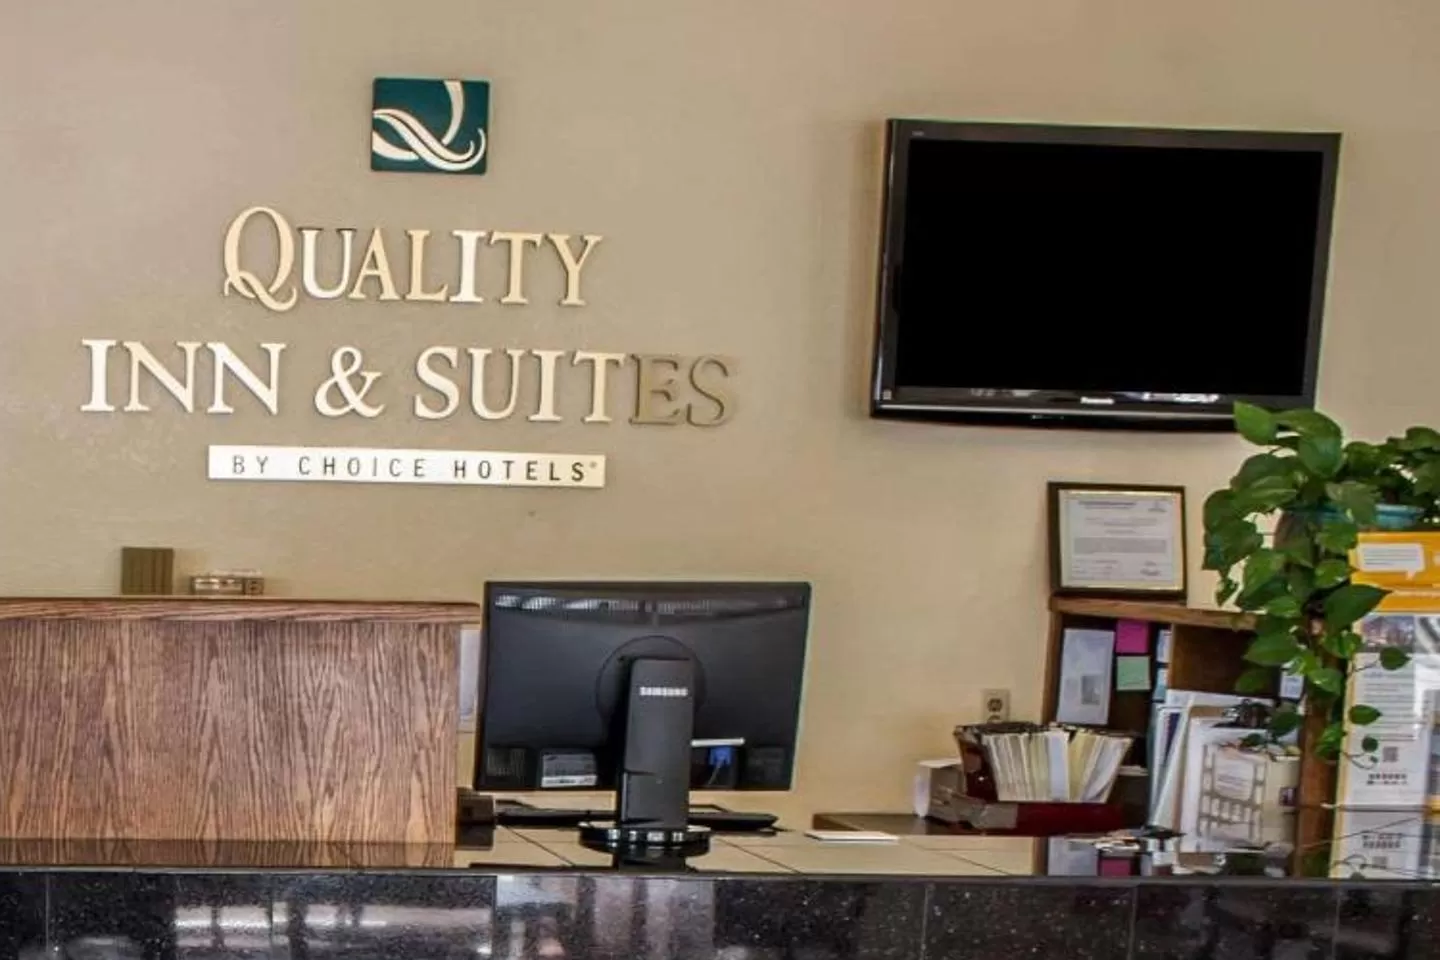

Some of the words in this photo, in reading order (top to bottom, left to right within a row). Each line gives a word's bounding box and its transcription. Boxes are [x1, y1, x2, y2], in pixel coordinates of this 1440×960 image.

[223, 205, 603, 311] QUALITY
[80, 338, 287, 415] INN
[314, 345, 384, 418] &
[413, 345, 738, 428] SUITES
[232, 454, 269, 475] BY
[298, 455, 427, 478] CHOICE
